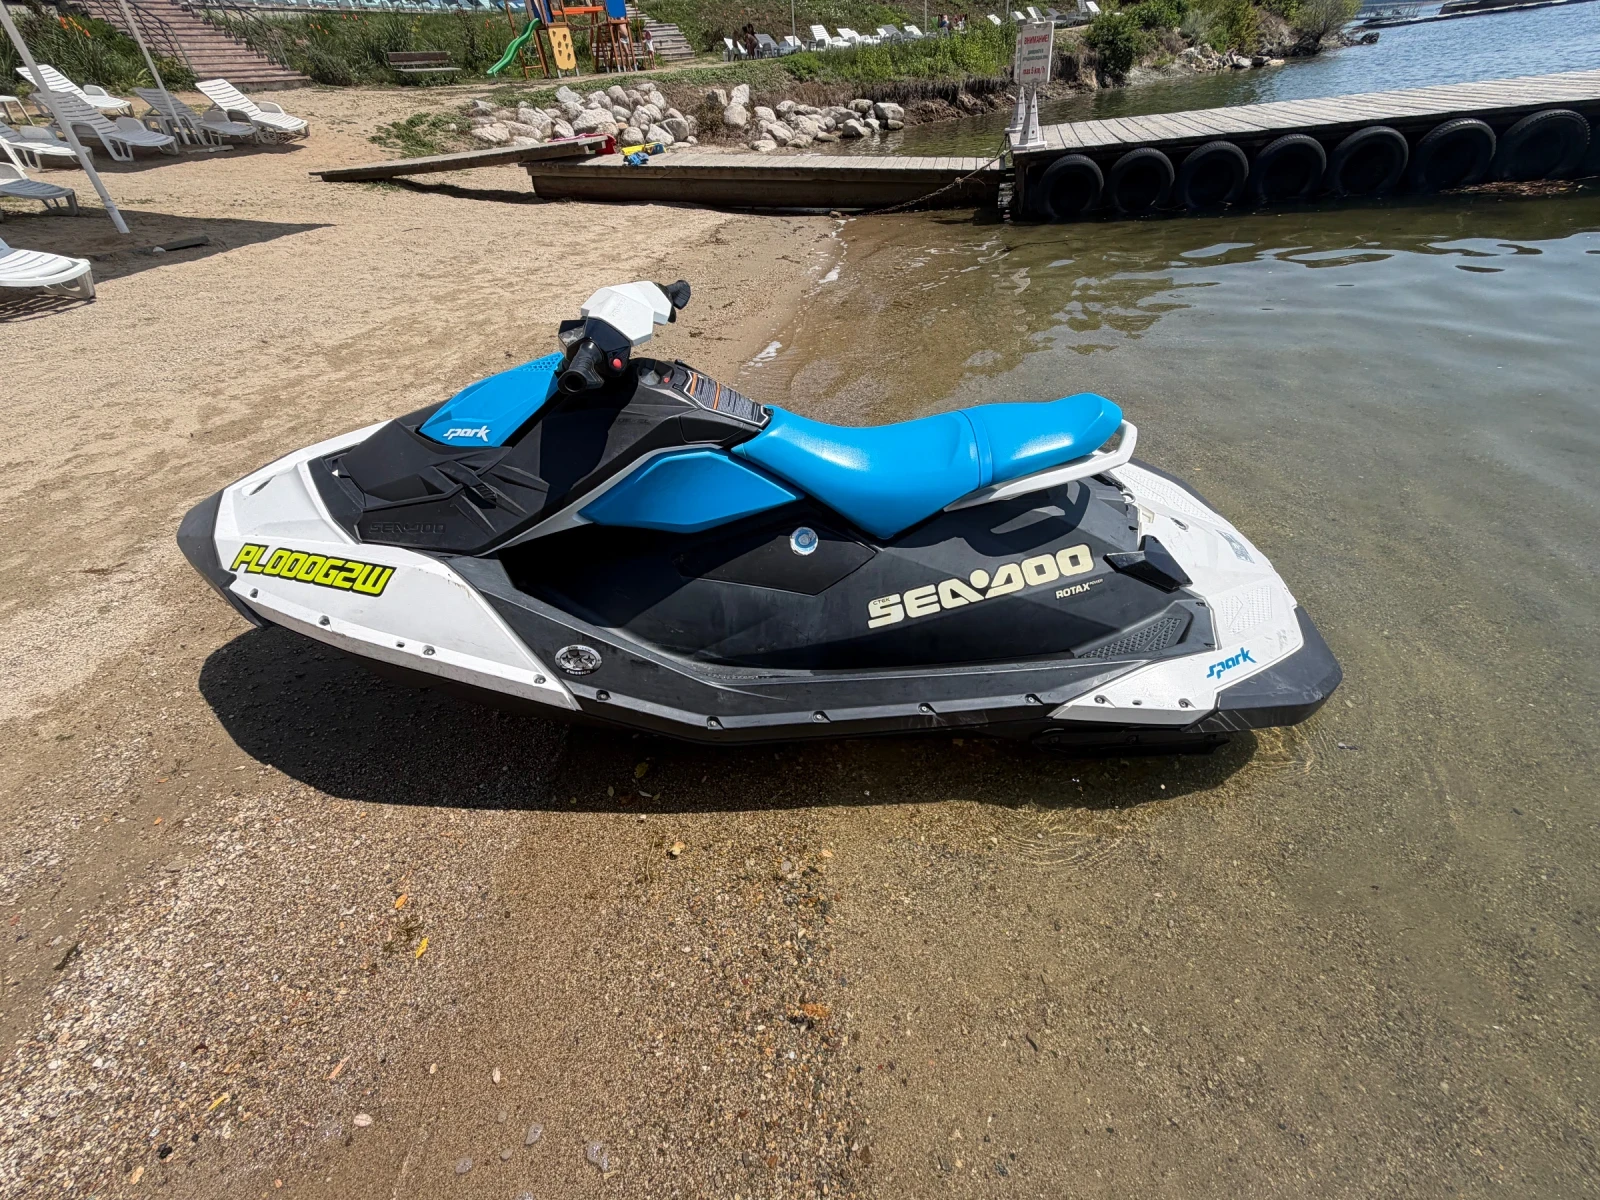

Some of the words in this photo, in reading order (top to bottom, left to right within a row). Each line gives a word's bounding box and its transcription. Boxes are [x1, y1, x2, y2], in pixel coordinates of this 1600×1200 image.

[443, 425, 491, 442] spark
[1055, 582, 1091, 599] ROTAX
[1206, 647, 1256, 679] spark
